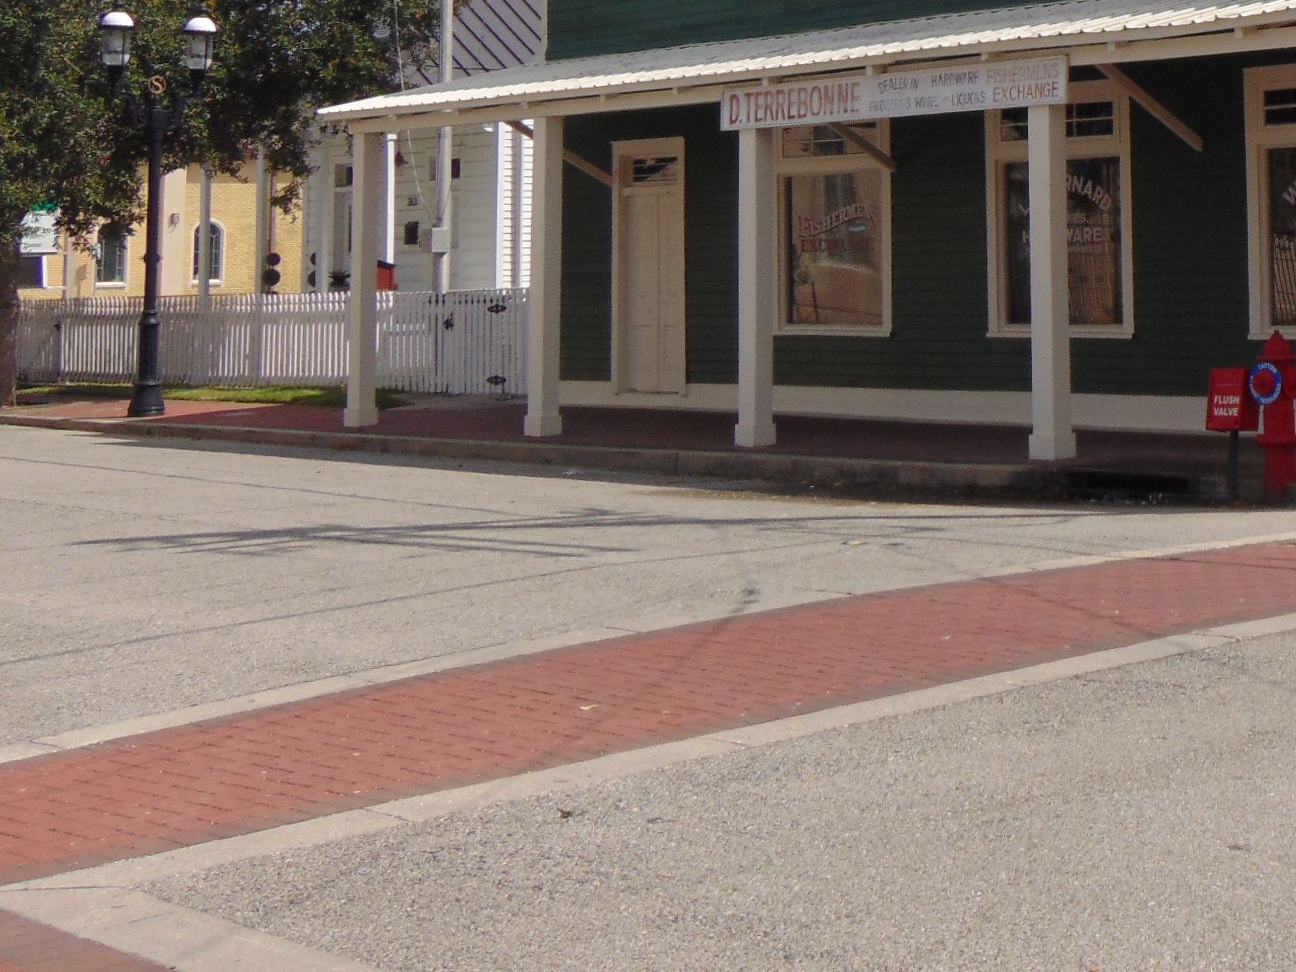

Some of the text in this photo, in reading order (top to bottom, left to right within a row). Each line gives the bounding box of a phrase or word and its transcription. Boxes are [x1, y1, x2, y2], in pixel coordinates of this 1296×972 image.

[931, 70, 979, 87] HARDWARE
[993, 81, 1059, 102] EXCHANGE
[1214, 395, 1240, 405] FLUSH
[1214, 407, 1239, 416] VALVE
